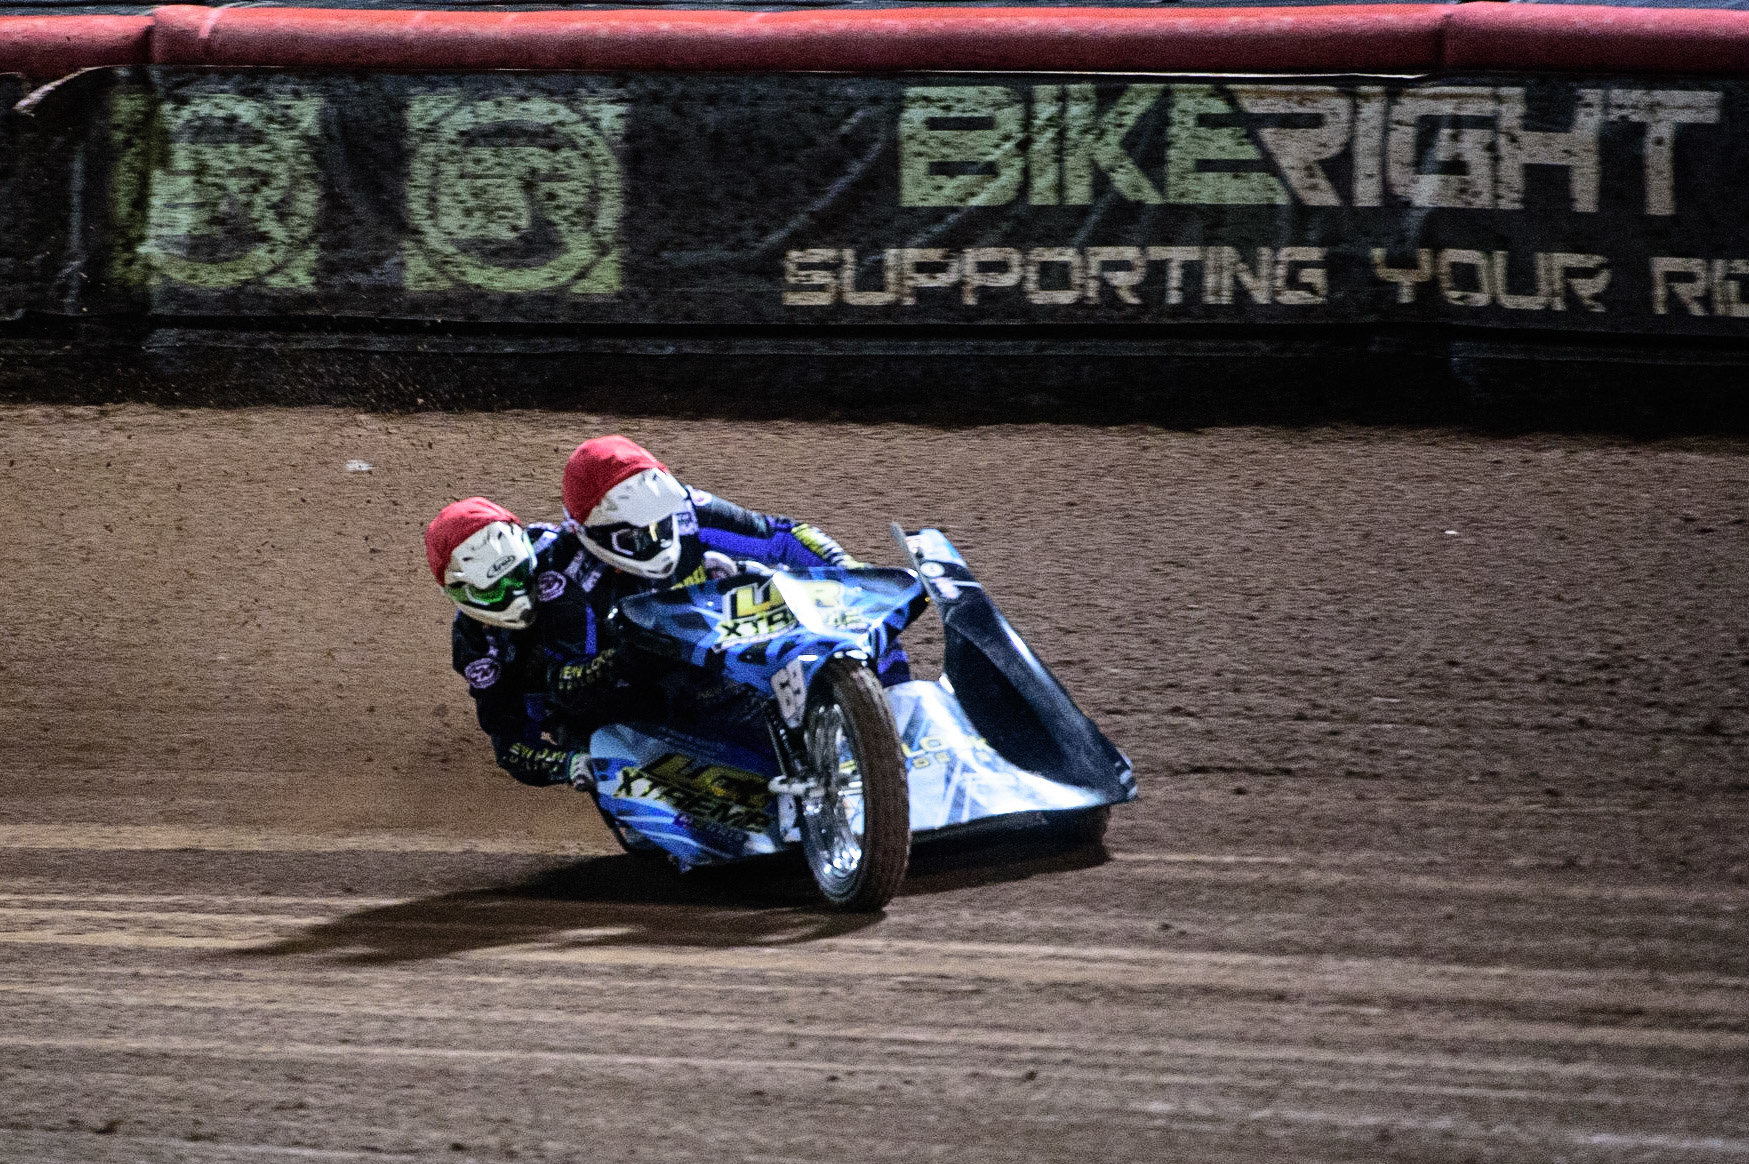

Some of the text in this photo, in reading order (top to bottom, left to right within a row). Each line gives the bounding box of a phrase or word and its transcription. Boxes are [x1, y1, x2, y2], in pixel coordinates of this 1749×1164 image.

[900, 83, 1724, 215] BIKERIGHT
[782, 244, 1328, 306] SUPPORTING
[1370, 247, 1613, 311] YOUR
